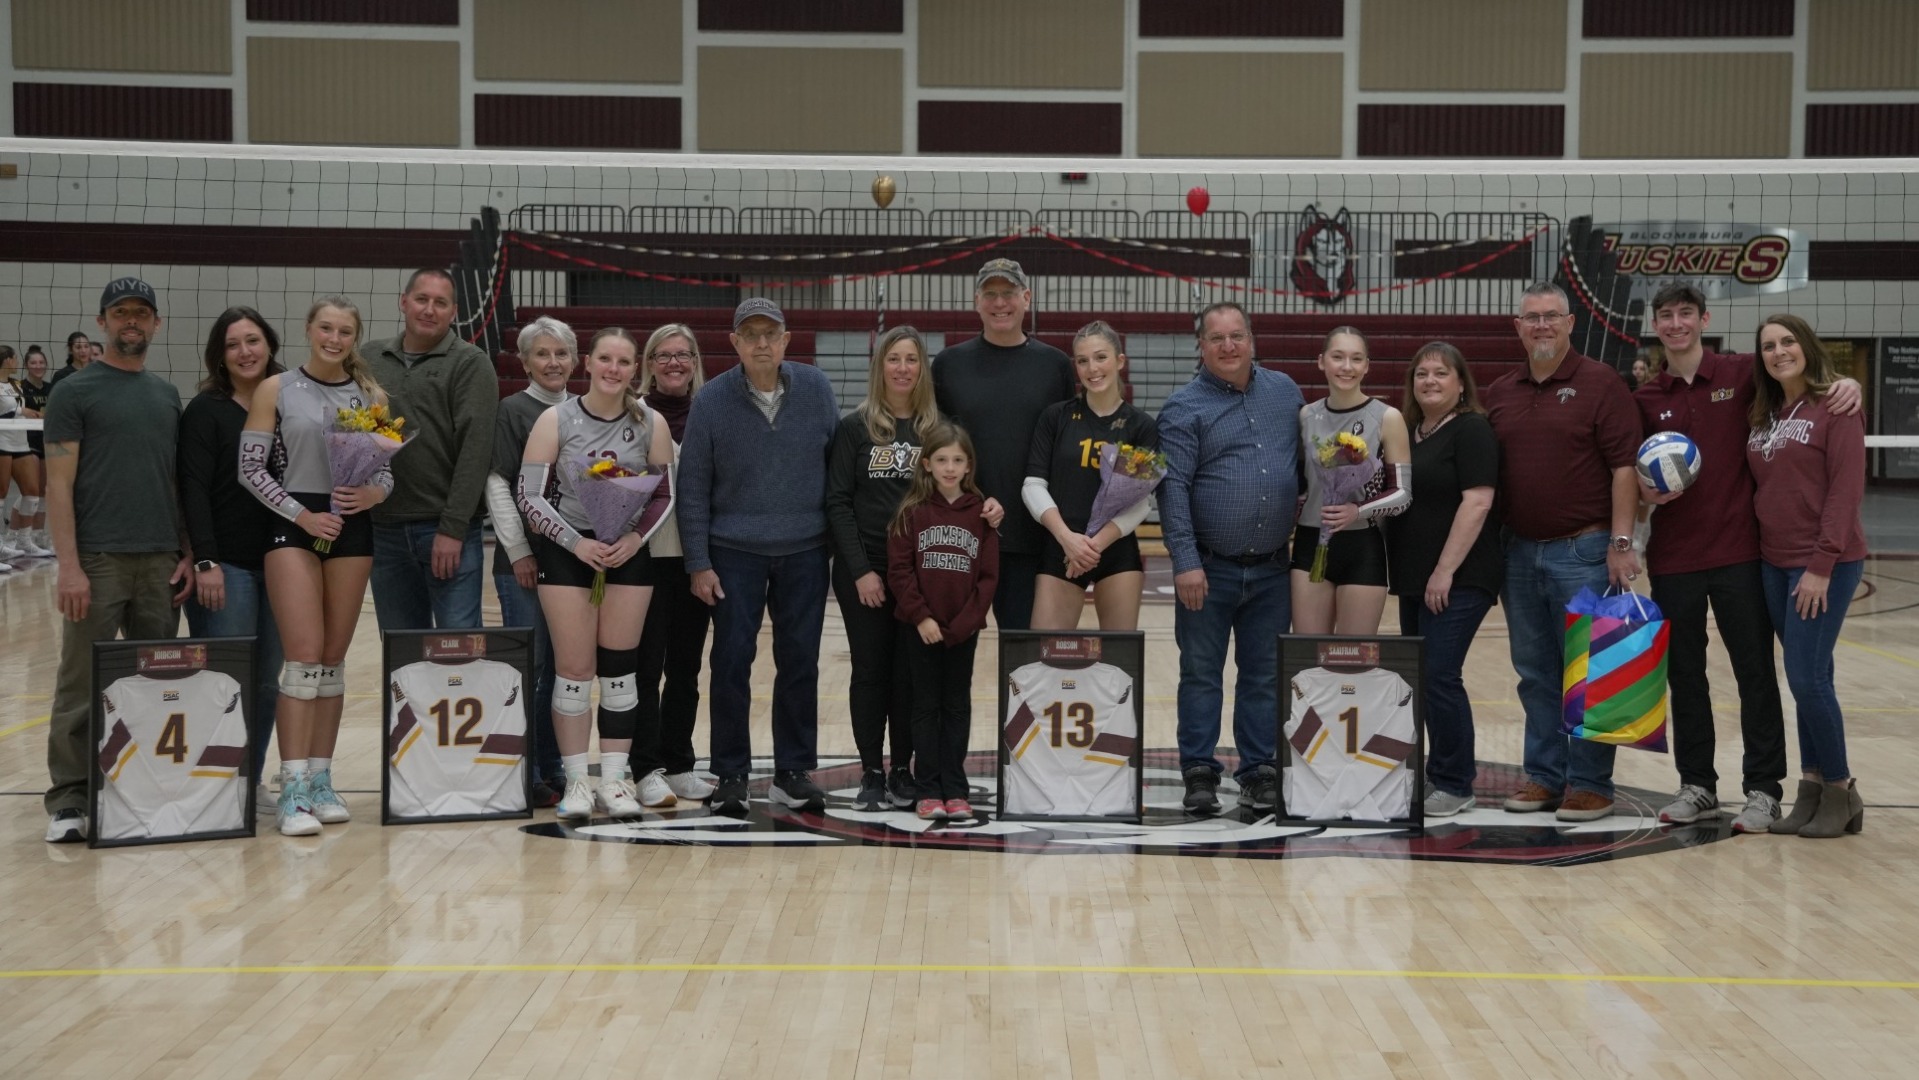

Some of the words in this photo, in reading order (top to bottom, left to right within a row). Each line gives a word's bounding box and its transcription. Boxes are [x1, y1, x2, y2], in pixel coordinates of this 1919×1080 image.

[1630, 231, 1744, 240] BLOOMSBURG
[112, 279, 150, 295] NYR
[241, 442, 288, 508] HUSKIES
[918, 525, 979, 559] BLOOMSBURG
[922, 552, 971, 573] HUSKIES
[441, 640, 460, 648] CLARK
[1056, 640, 1078, 650] ROBSON
[1329, 647, 1360, 655] SAALFRANK
[154, 651, 181, 660] JOHNSON
[428, 696, 484, 747] 12
[1042, 700, 1096, 749] 13
[1337, 706, 1358, 755] 1
[154, 712, 189, 764] 4
